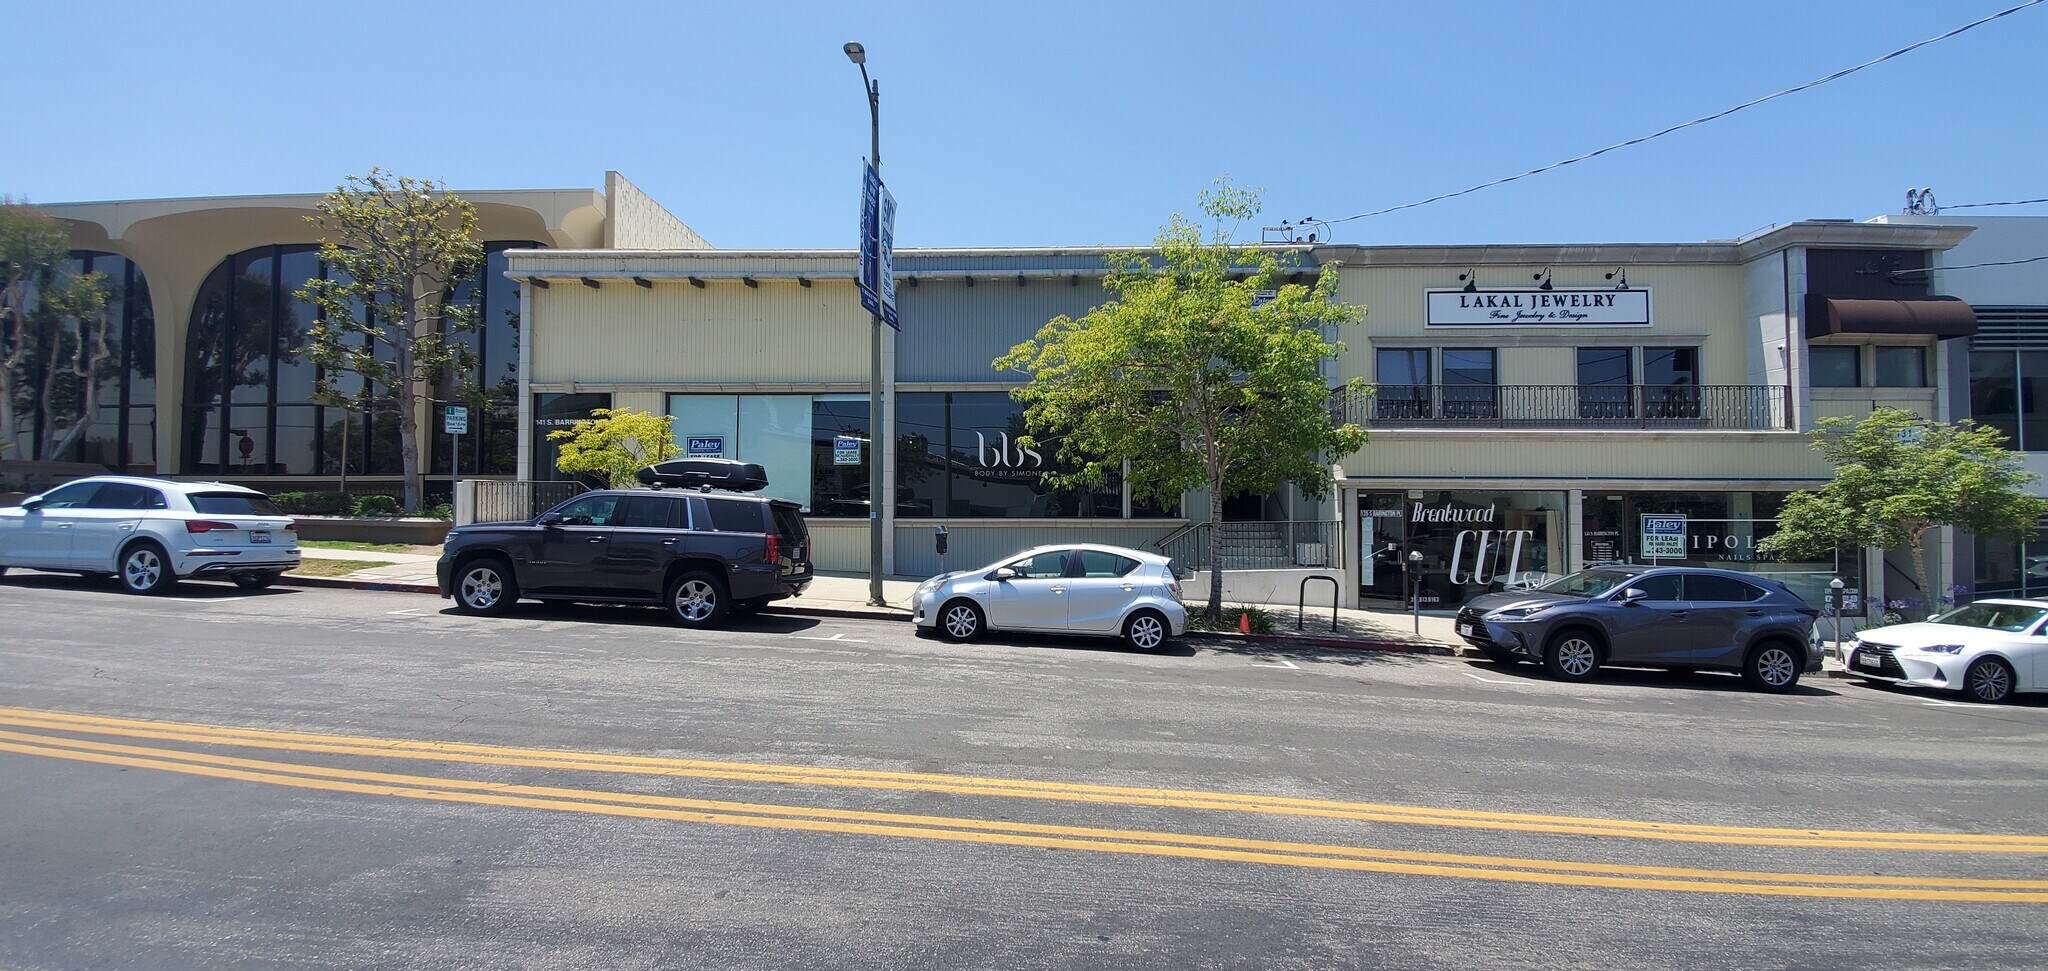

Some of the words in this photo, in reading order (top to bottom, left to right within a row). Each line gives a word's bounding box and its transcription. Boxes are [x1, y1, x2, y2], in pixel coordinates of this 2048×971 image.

[1459, 295, 1523, 308] LAKAL
[1530, 294, 1617, 309] JEWELRY
[1489, 310, 1509, 319] Fine
[1511, 310, 1546, 322] Jewelry
[1558, 310, 1588, 322] Design
[691, 440, 721, 449] Paley
[975, 430, 1042, 468] bbs
[1411, 502, 1495, 523] Brentwood
[1692, 535, 1758, 549] IPOL
[1449, 530, 1534, 585] CUT
